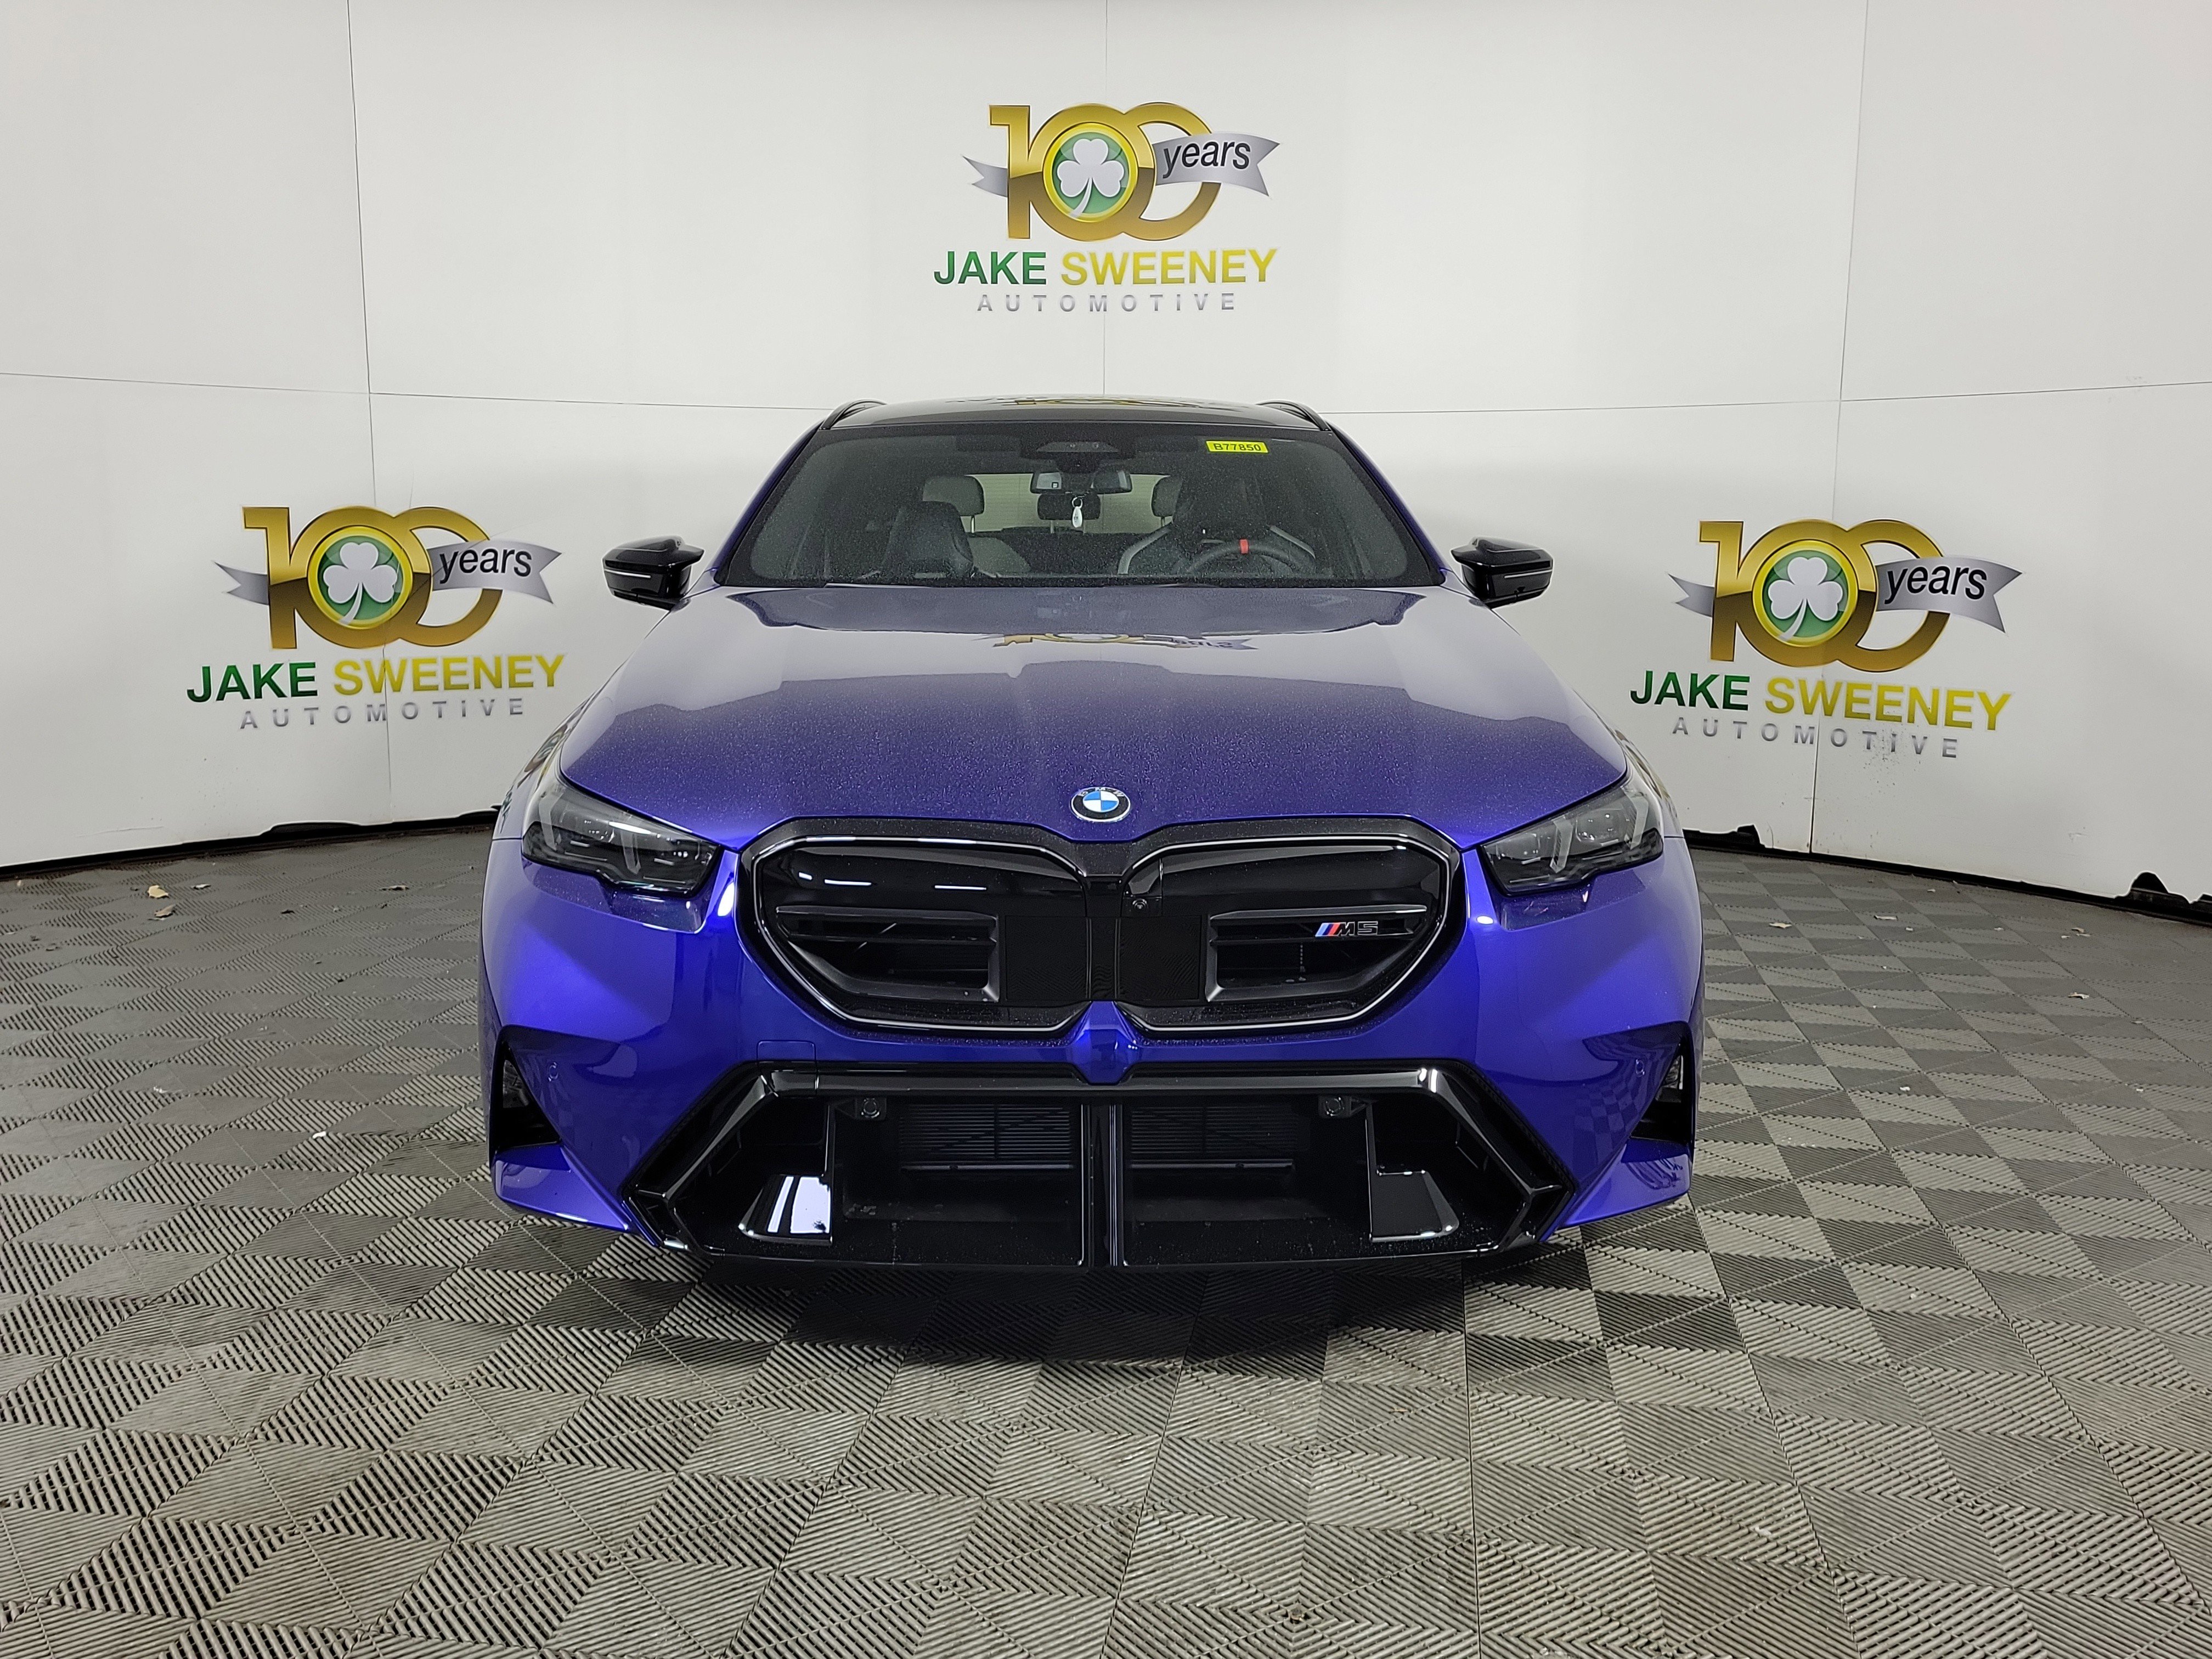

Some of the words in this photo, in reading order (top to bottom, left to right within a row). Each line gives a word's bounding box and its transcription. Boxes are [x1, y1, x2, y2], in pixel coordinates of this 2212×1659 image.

[989, 101, 1222, 242] 100
[1162, 140, 1251, 179] years
[933, 251, 1047, 285] JAKE
[1060, 248, 1278, 285] SWEENEY
[977, 292, 1235, 312] AUTOMOTIVE
[242, 506, 504, 649] 100
[439, 548, 533, 584] years
[1699, 518, 1950, 673] 100
[1884, 566, 1988, 604] years
[187, 662, 318, 703] JAKE
[334, 654, 565, 696] SWEENEY
[1630, 670, 1751, 711] JAKE
[1764, 677, 2012, 731] SWEENEY
[240, 698, 523, 730] AUTOMOTIVE
[1672, 717, 1958, 758] AUTOMOTIVE
[1333, 921, 1378, 936] M5
